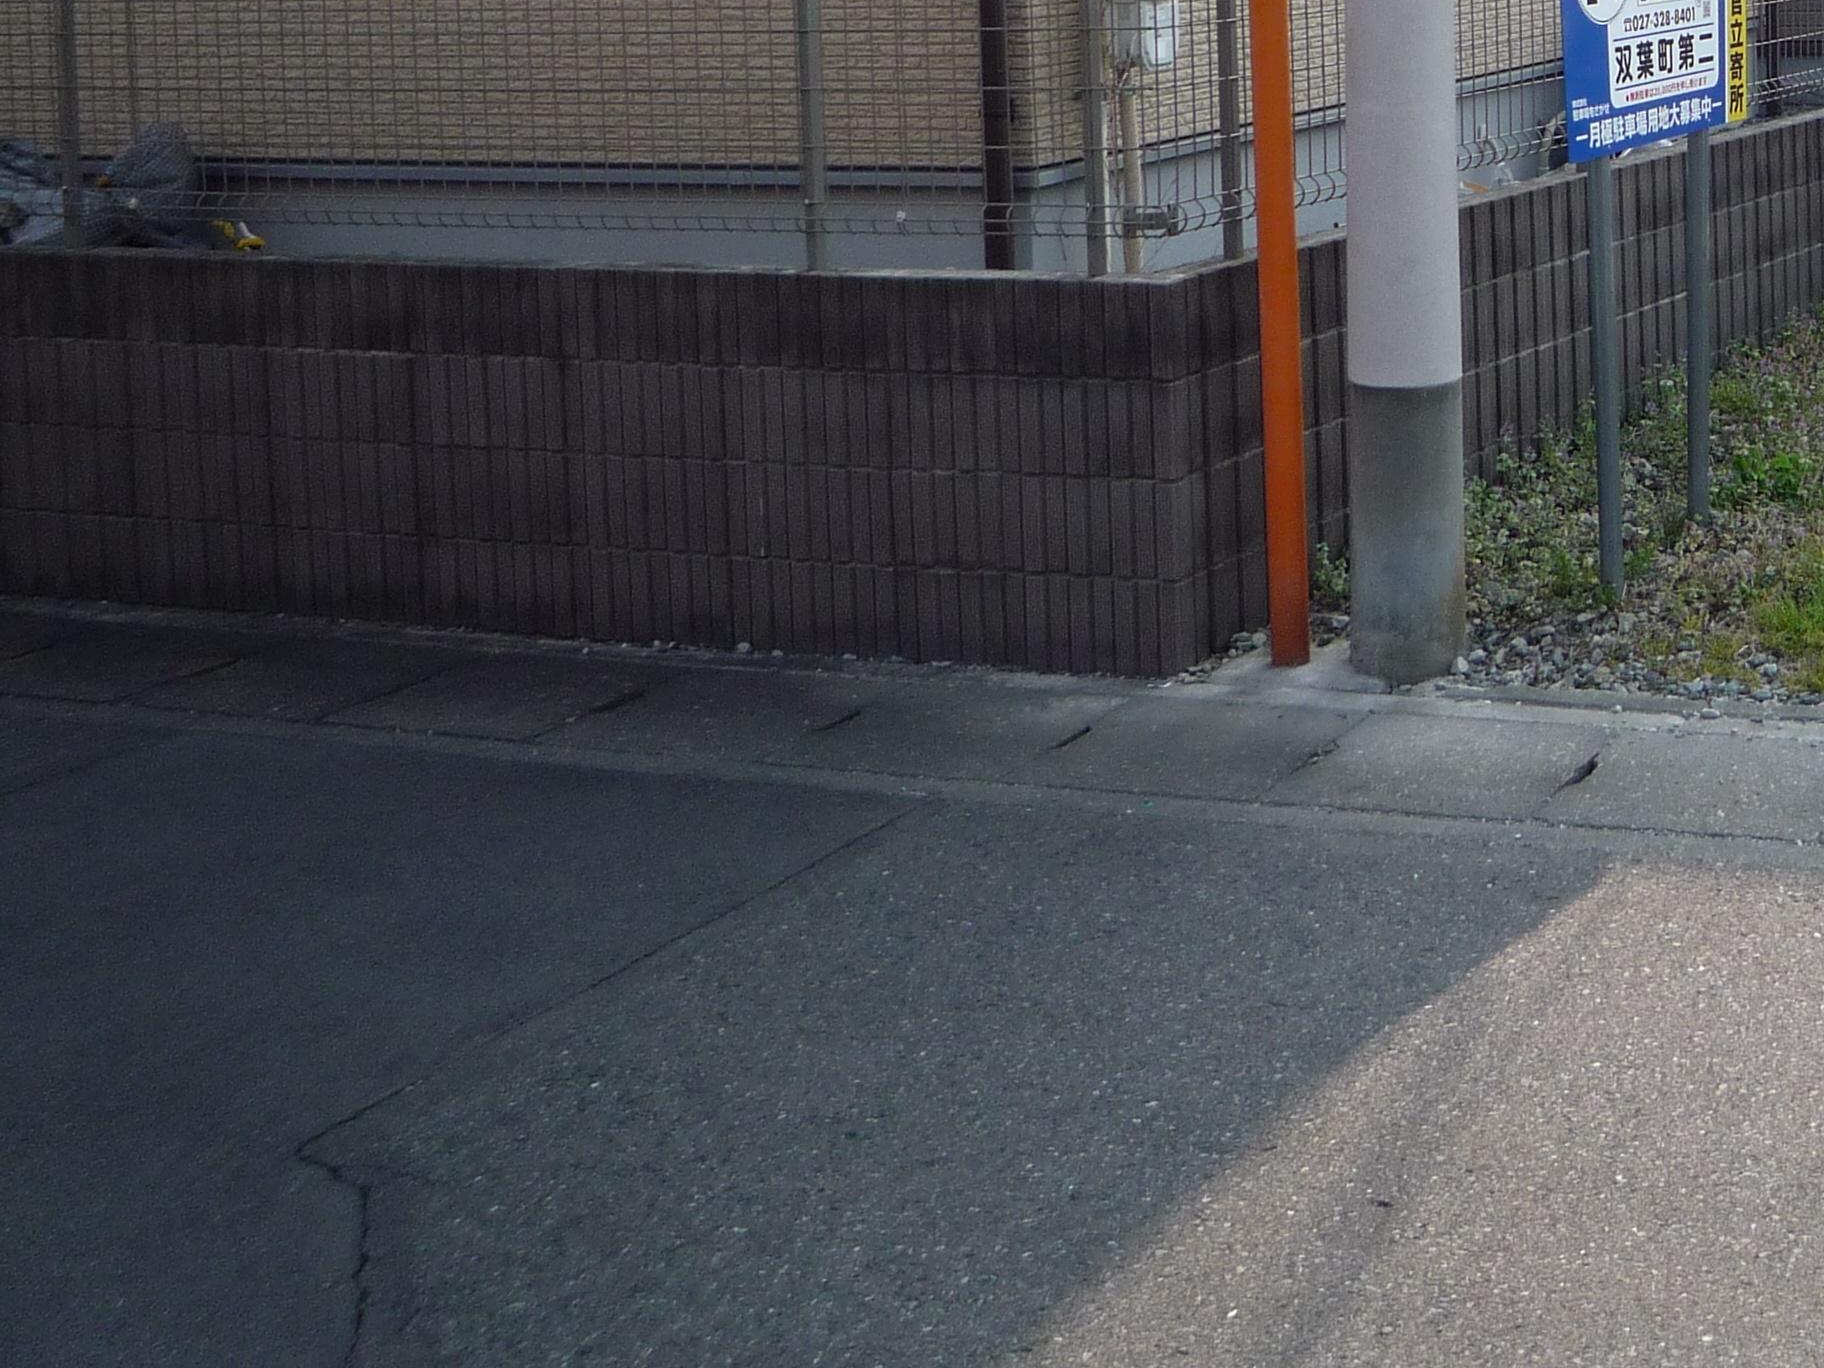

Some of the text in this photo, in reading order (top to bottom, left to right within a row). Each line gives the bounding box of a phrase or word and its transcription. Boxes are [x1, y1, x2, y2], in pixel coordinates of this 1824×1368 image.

[1615, 32, 1714, 85] 双葉町第二
